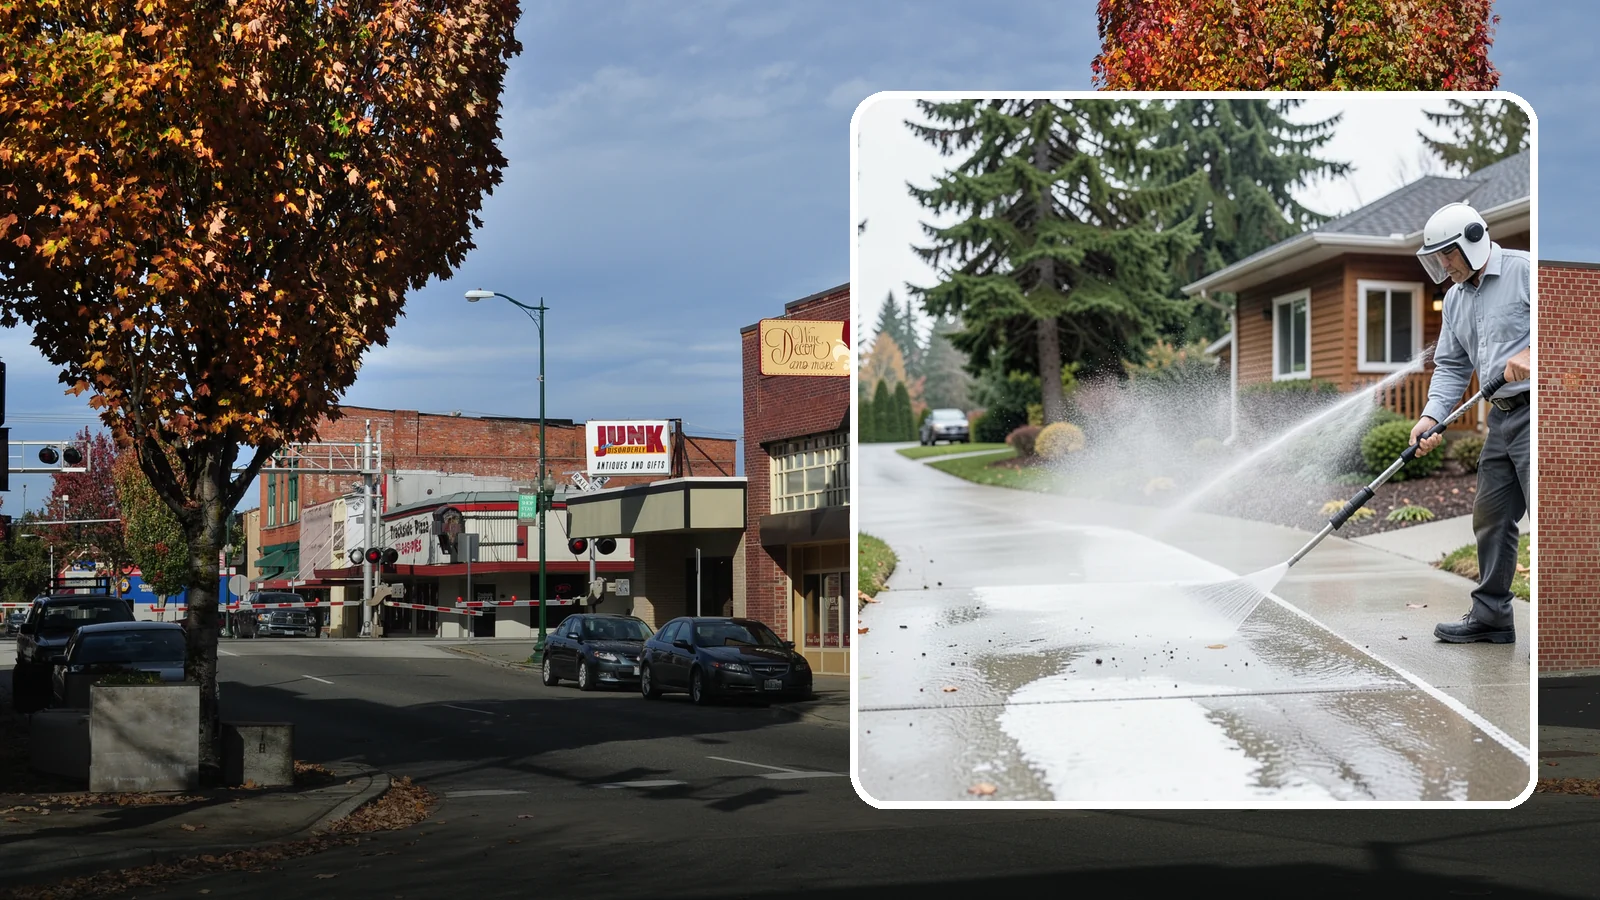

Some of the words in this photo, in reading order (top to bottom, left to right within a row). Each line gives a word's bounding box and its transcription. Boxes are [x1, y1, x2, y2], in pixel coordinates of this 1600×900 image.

[595, 425, 665, 457] JUNK
[607, 446, 646, 454] DISORDERLY
[597, 461, 628, 470] ANTIQUES
[631, 461, 644, 469] AND
[646, 460, 665, 469] GIFTS
